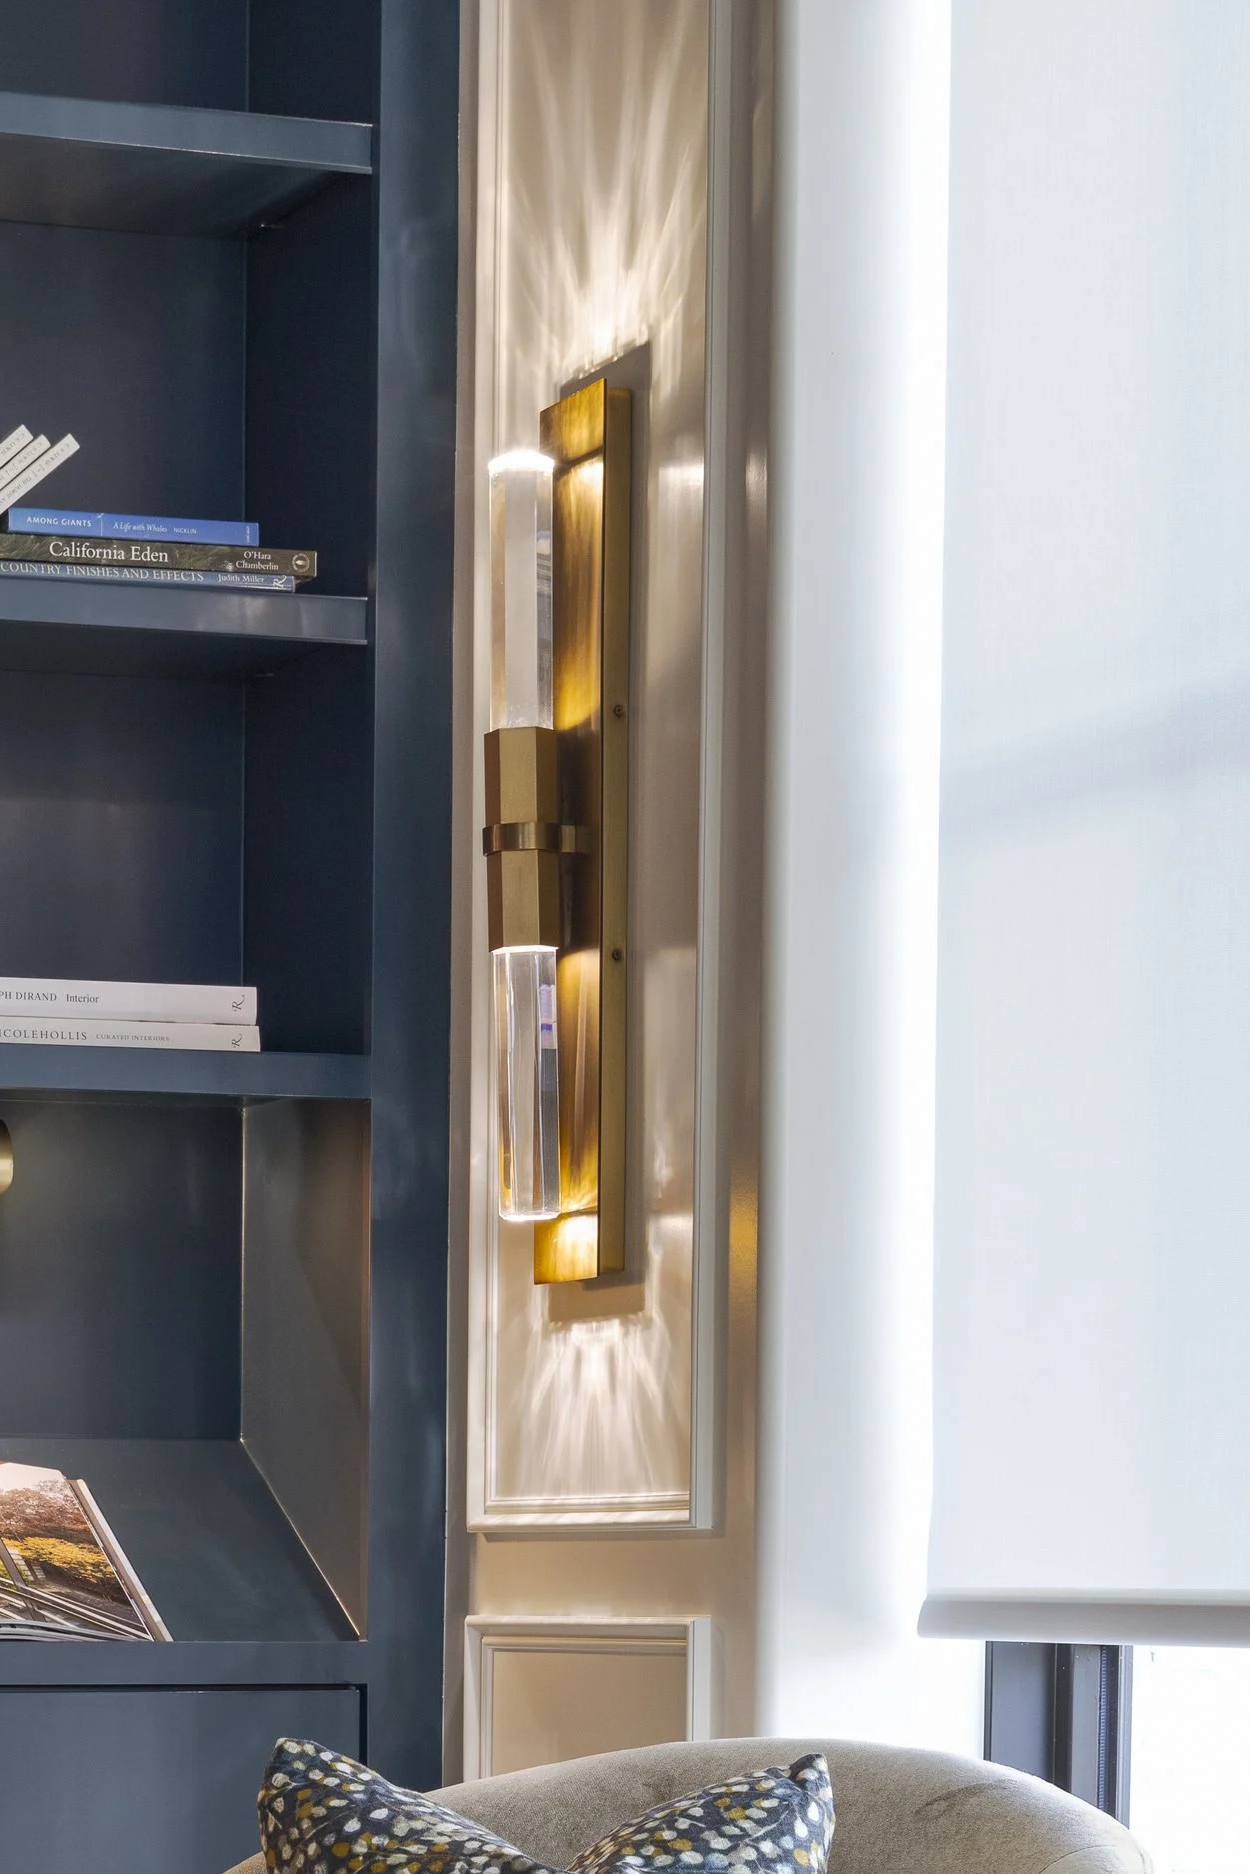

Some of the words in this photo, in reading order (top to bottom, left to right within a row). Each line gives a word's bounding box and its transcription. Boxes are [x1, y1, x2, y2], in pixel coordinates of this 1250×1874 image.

[26, 516, 58, 525] AMONG
[61, 518, 92, 527] GIANTS
[173, 527, 197, 535] NICKLIN
[49, 541, 125, 560] California
[130, 546, 169, 562] Eden
[235, 560, 279, 571] Chamberlin
[0, 562, 61, 575] COUNTRY
[66, 566, 119, 578] FINISHES
[121, 569, 149, 579] AND
[152, 570, 204, 582] EFFECTS
[217, 574, 240, 583] Judith
[15, 992, 57, 1001] DIRAND
[66, 994, 100, 1003] Interior
